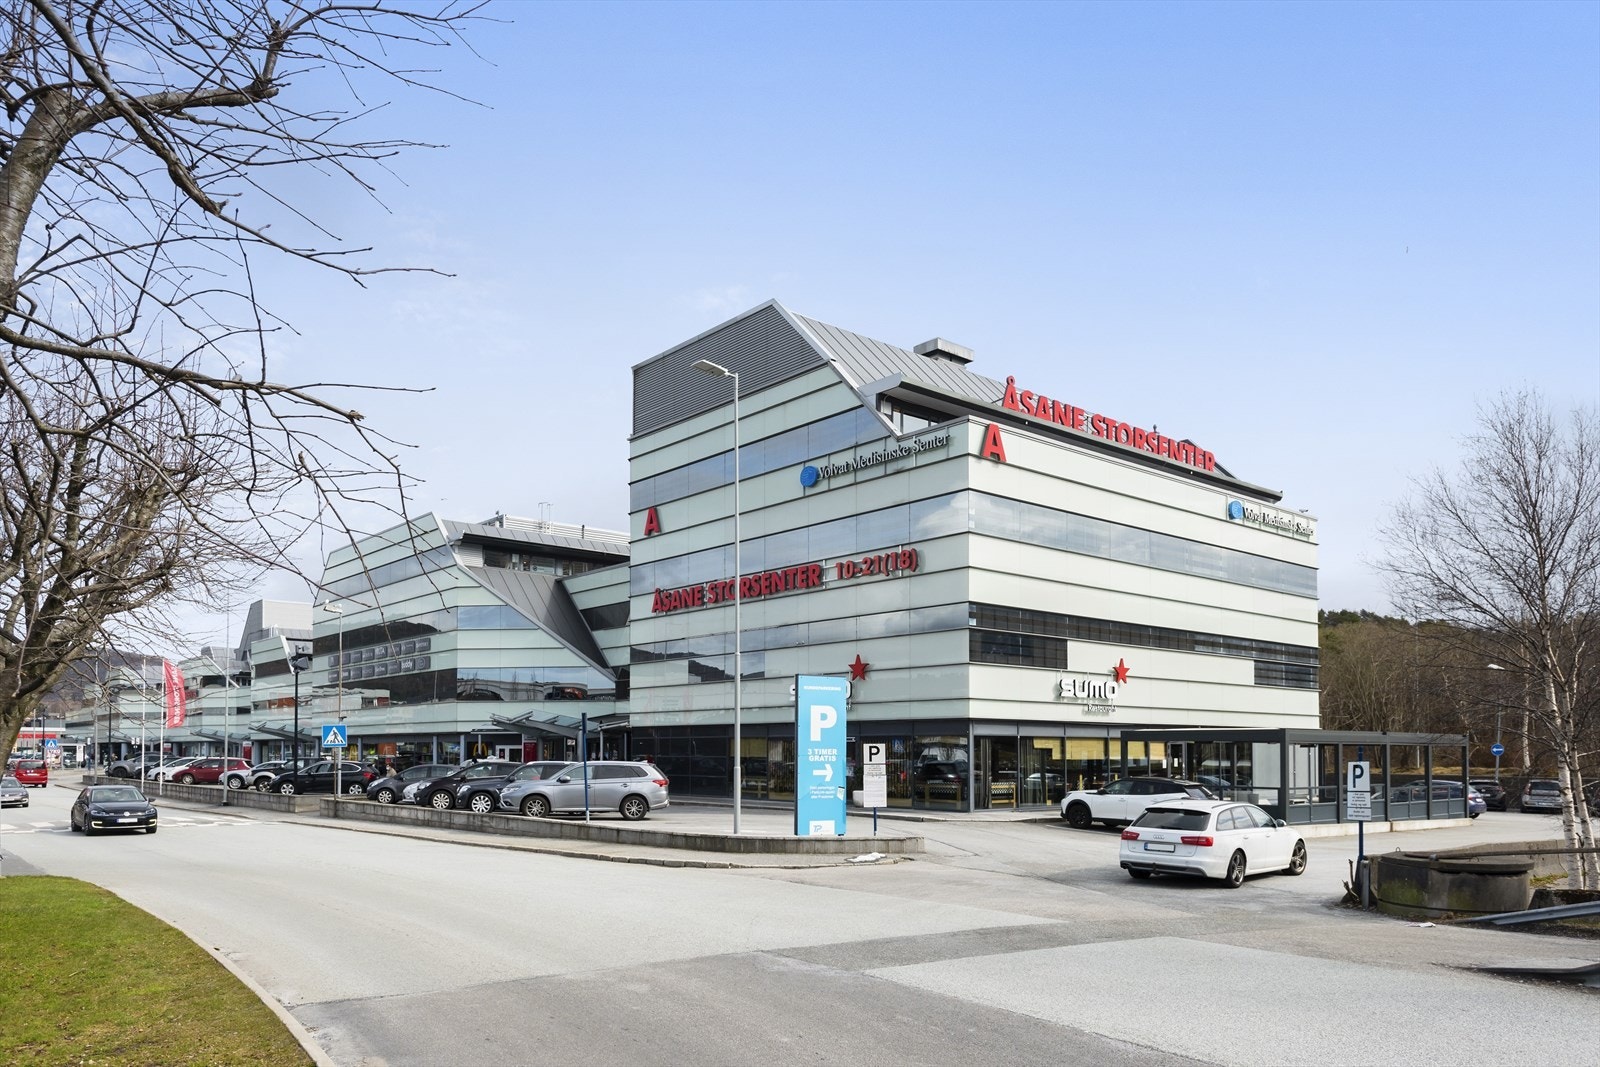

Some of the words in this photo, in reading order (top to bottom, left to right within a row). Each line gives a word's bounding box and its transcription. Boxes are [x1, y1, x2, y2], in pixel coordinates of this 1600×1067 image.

[980, 422, 1007, 463] A
[1001, 375, 1087, 432] ÅSANE
[1091, 413, 1216, 472] STORSENTER
[818, 460, 851, 479] Volvat
[850, 443, 910, 471] Medisinske
[911, 433, 951, 454] Senter
[644, 506, 661, 537] A
[652, 587, 705, 614] ÅSANE
[707, 563, 822, 604] STORSENTER
[835, 548, 918, 581] 10-21(18)
[810, 704, 838, 742] P
[807, 748, 813, 756] 3
[814, 748, 838, 756] TIMER
[869, 745, 881, 762] P
[1353, 764, 1365, 789] P
